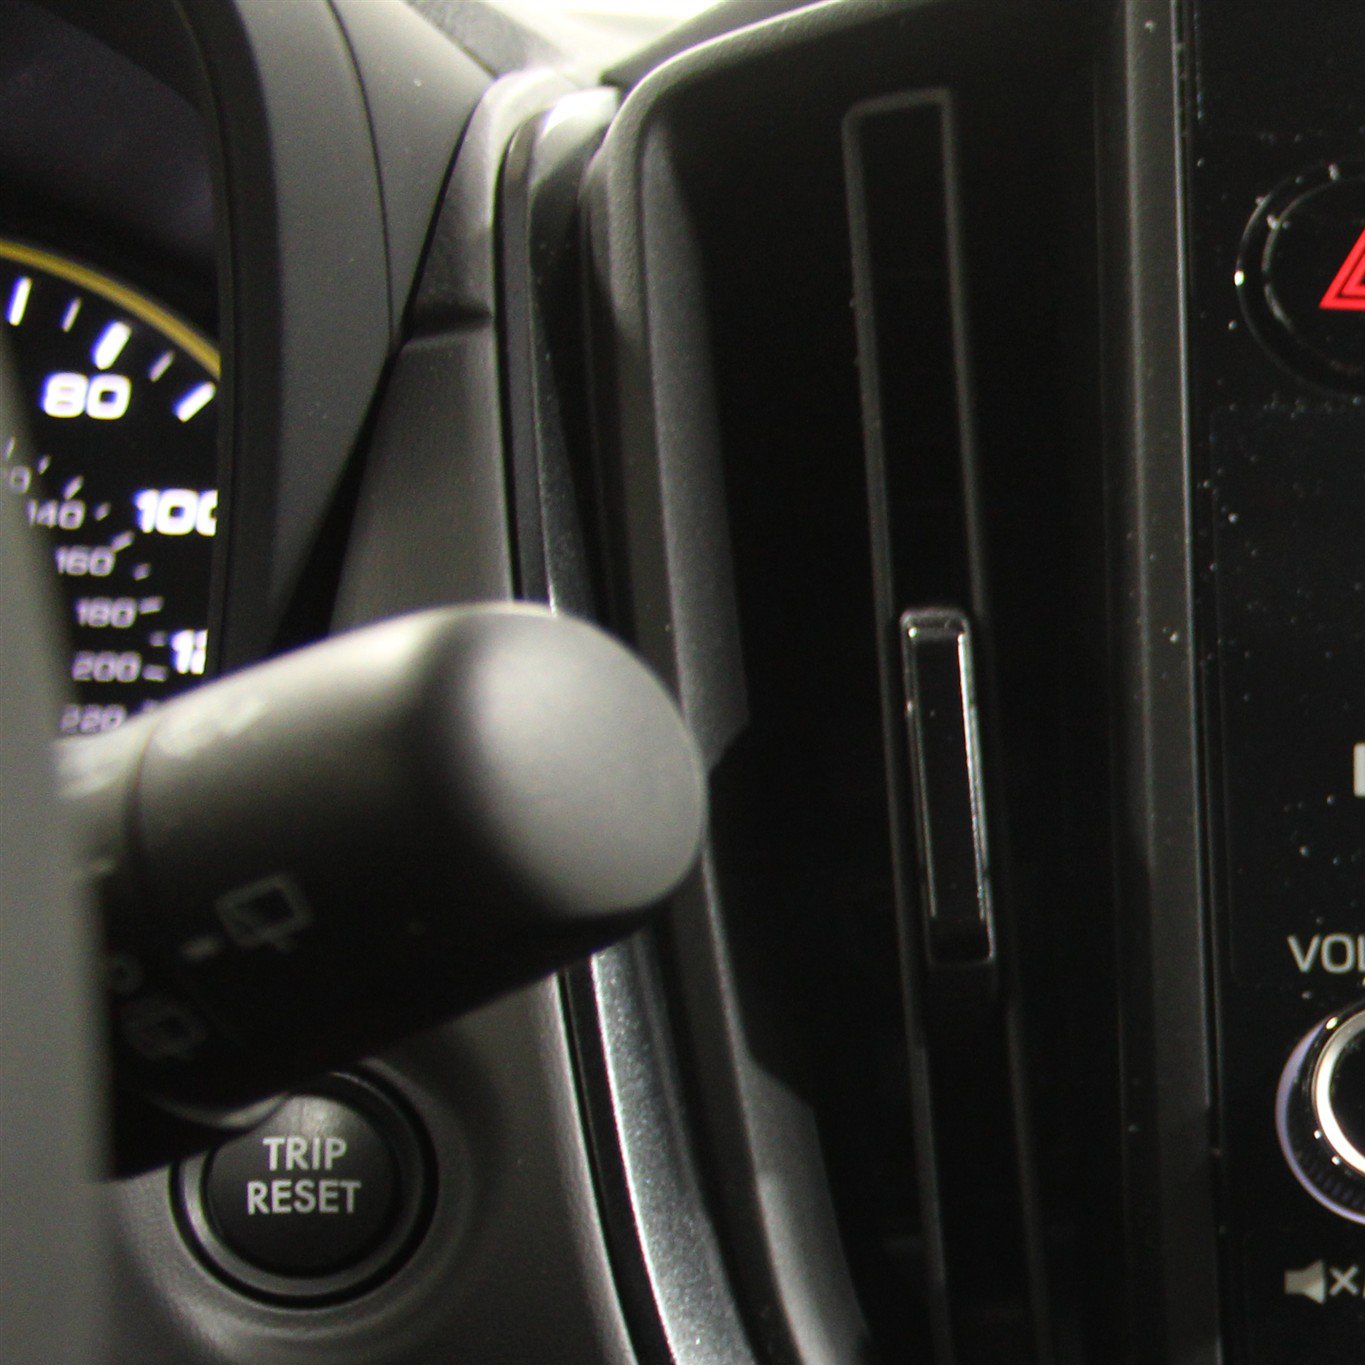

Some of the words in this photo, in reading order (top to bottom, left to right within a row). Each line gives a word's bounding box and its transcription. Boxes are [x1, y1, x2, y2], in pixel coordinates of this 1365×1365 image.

[42, 371, 131, 420] 80
[26, 499, 86, 531] 140
[55, 545, 116, 577] 160
[74, 597, 138, 629] 180
[72, 651, 142, 684] 200
[59, 704, 128, 734] 220
[262, 1136, 347, 1171] TRIP
[247, 1179, 361, 1215] RESET
